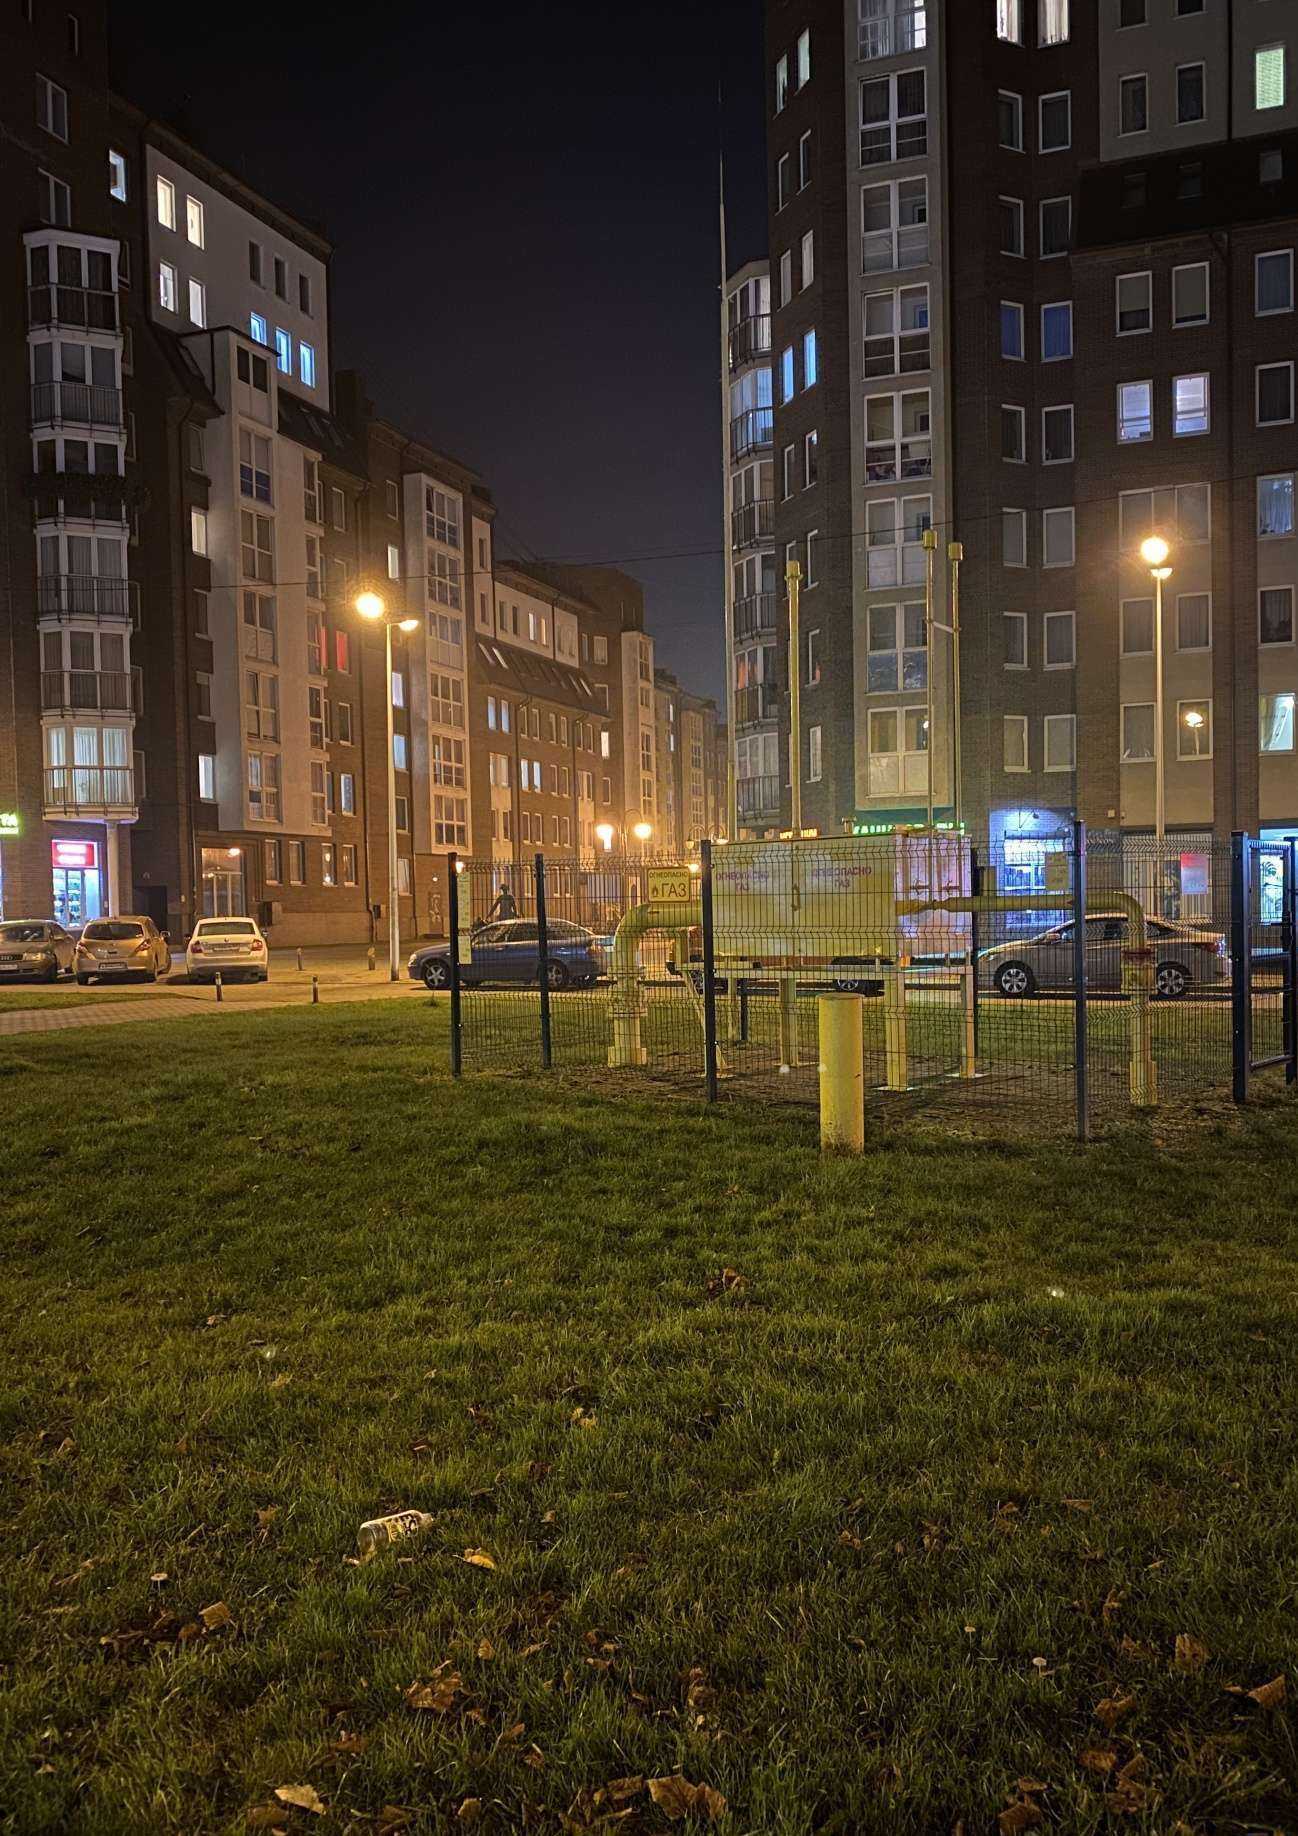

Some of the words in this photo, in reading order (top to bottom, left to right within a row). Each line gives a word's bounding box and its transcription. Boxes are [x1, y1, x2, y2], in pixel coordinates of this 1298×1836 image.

[649, 871, 689, 879] ОГНЕОПАСНО
[834, 878, 850, 888] ГАЗ
[661, 882, 687, 898] ГАЗ
